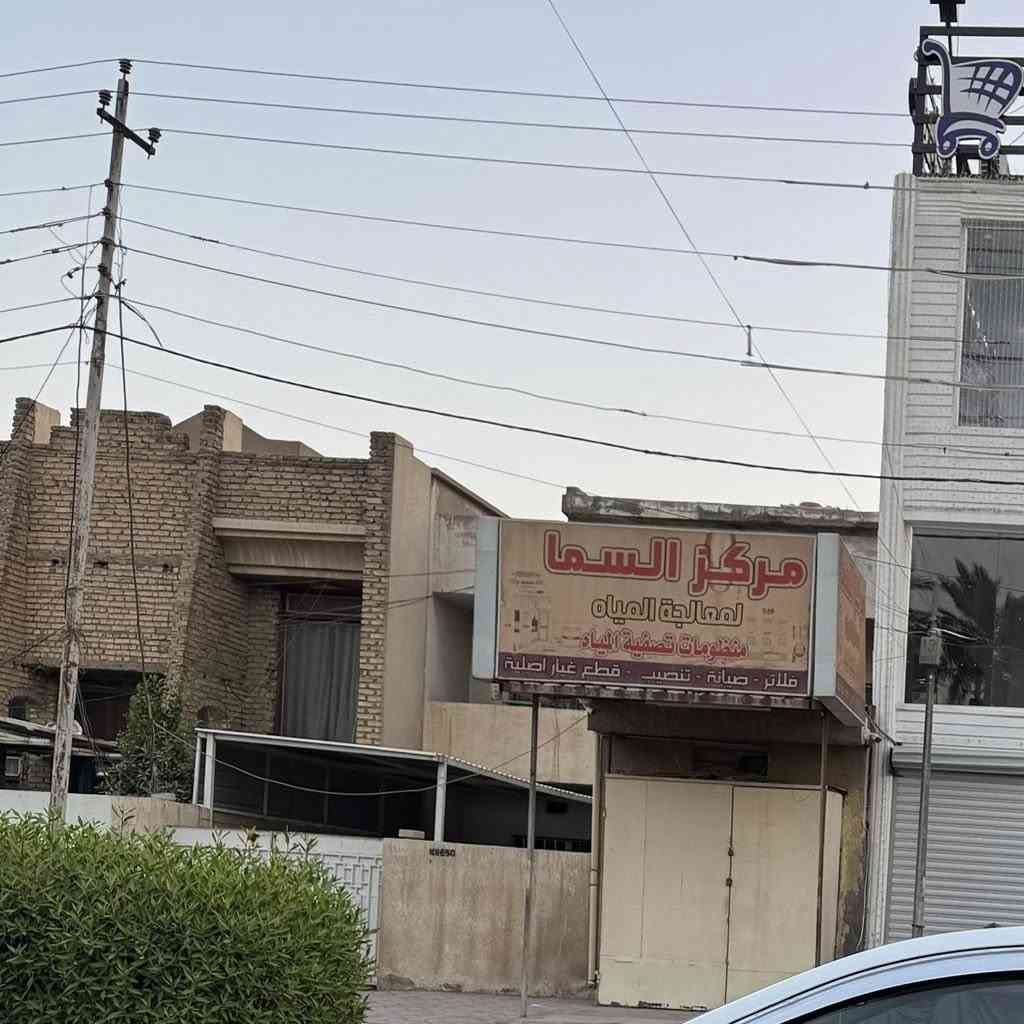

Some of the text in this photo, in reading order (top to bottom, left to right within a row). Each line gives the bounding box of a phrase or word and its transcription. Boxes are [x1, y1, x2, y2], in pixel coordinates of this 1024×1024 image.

[544, 529, 808, 600] مركز السما
[591, 594, 744, 629] لمعالجة المياه
[504, 656, 546, 673] اصلية
[582, 661, 621, 679] قطع
[706, 669, 749, 689] صيانة
[763, 671, 799, 690] فلاتر
